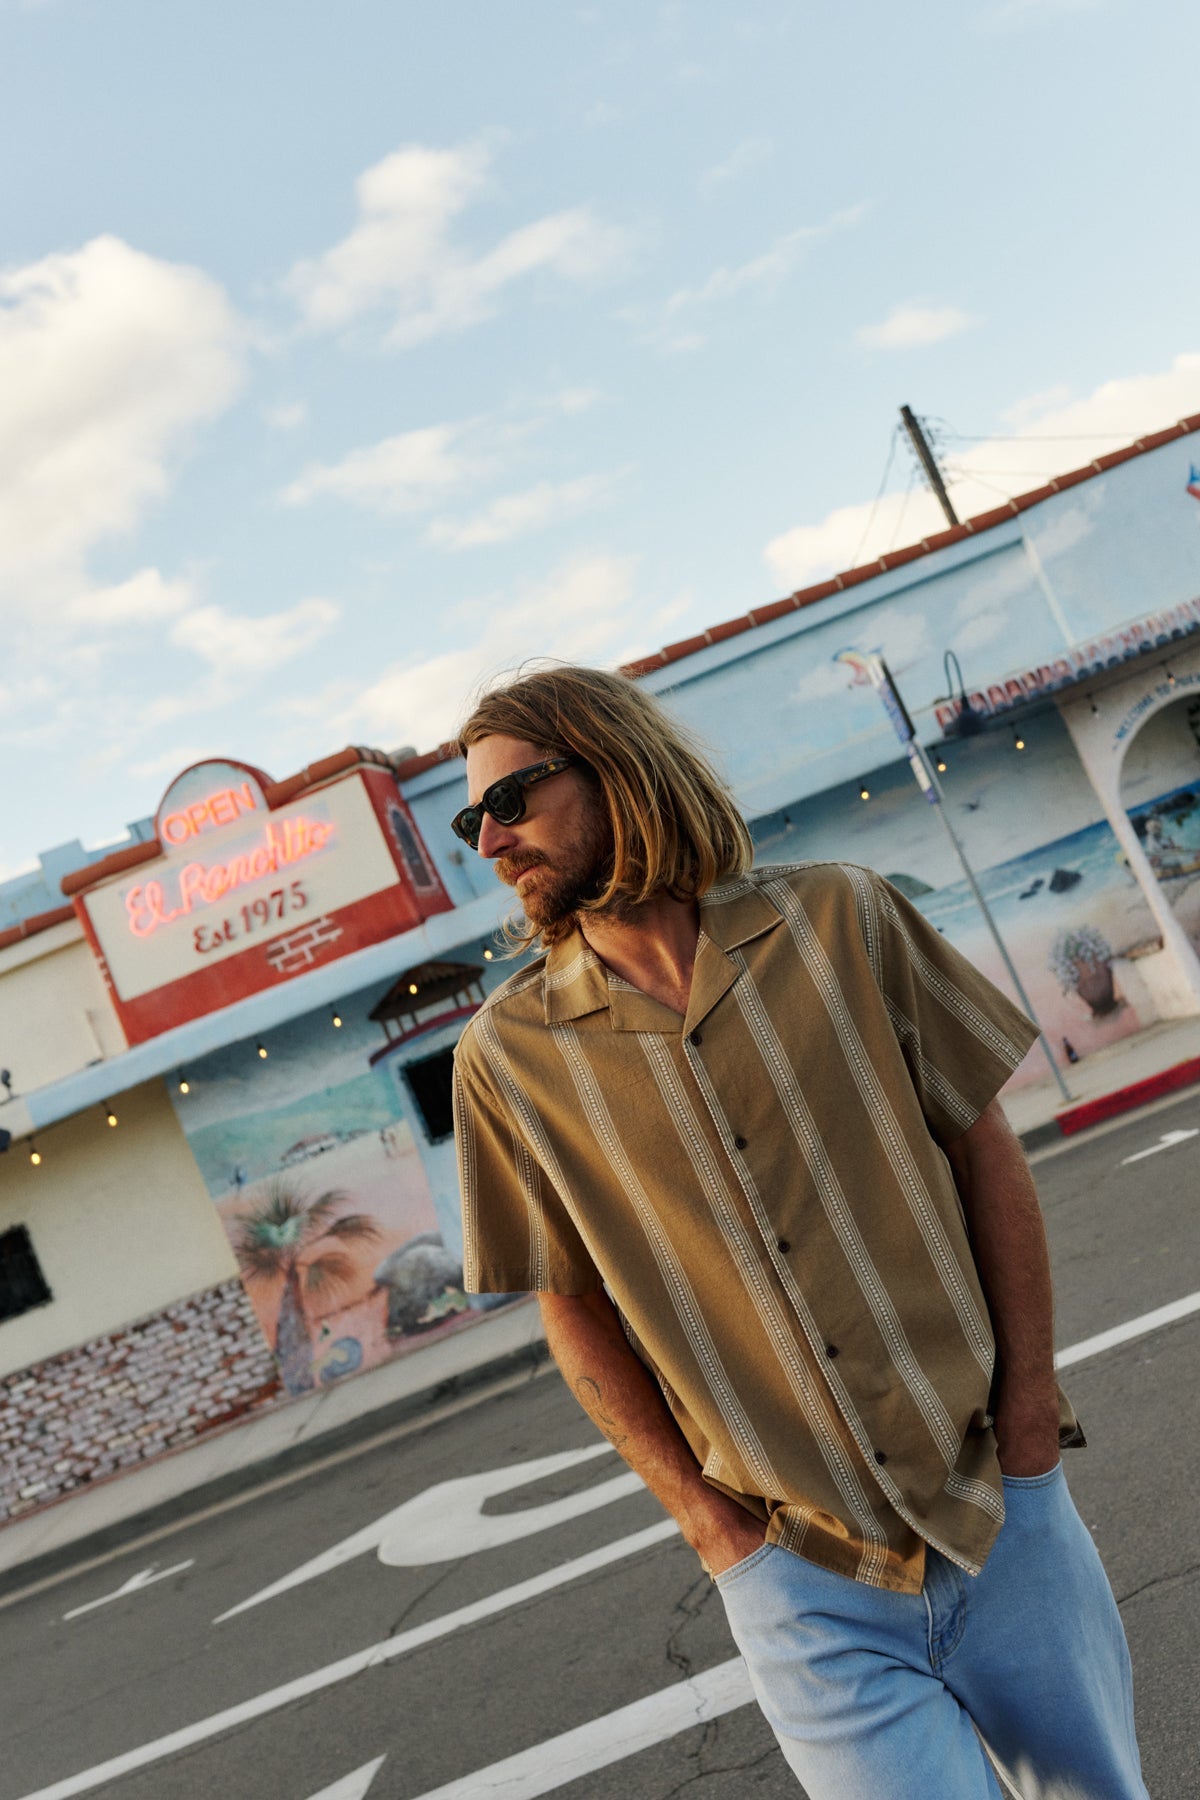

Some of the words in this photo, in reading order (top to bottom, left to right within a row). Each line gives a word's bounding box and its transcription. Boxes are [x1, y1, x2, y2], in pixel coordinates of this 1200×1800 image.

[162, 782, 256, 845] OPEN
[125, 881, 172, 937] El
[175, 816, 334, 914] Ranchito
[193, 919, 236, 954] Est
[240, 881, 308, 933] 1975
